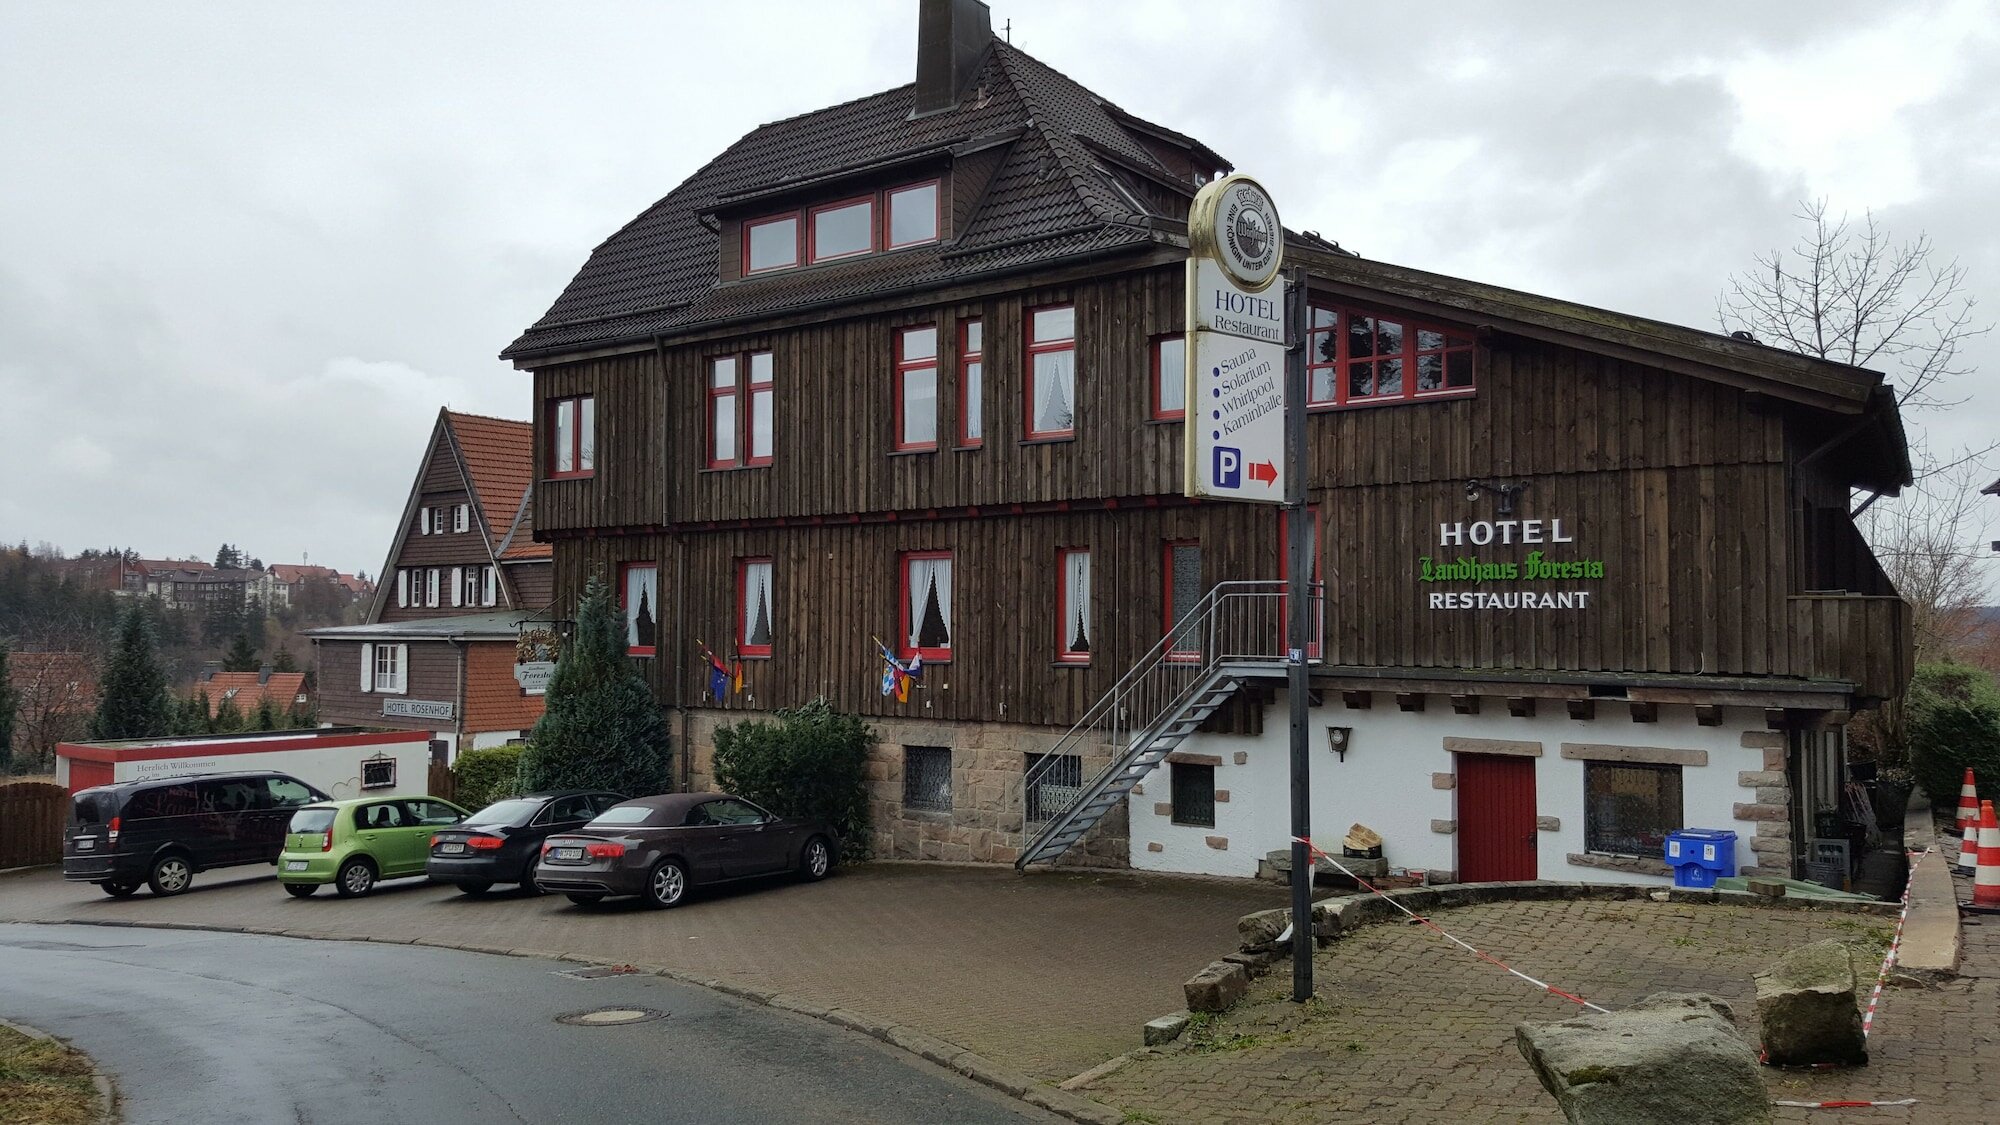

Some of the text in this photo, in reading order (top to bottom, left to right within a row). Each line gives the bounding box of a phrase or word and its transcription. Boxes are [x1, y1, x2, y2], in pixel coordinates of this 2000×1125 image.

[1242, 258, 1264, 271] UNTER
[1216, 290, 1280, 322] HOTEL
[1215, 315, 1279, 340] Restaurant
[1221, 348, 1257, 374] Sauna
[1221, 361, 1271, 395] Solarium
[1222, 377, 1275, 414] Whirlpool
[1223, 394, 1283, 436] Kaminhalle
[1220, 451, 1238, 484] P
[1440, 518, 1573, 547] HOTEL
[1418, 550, 1605, 586] Landhaus Foresta
[1429, 591, 1590, 610] RESTAURANT
[386, 703, 450, 716] HOTEL ROSENHOF
[137, 761, 216, 772] Herzlich Willkommen
